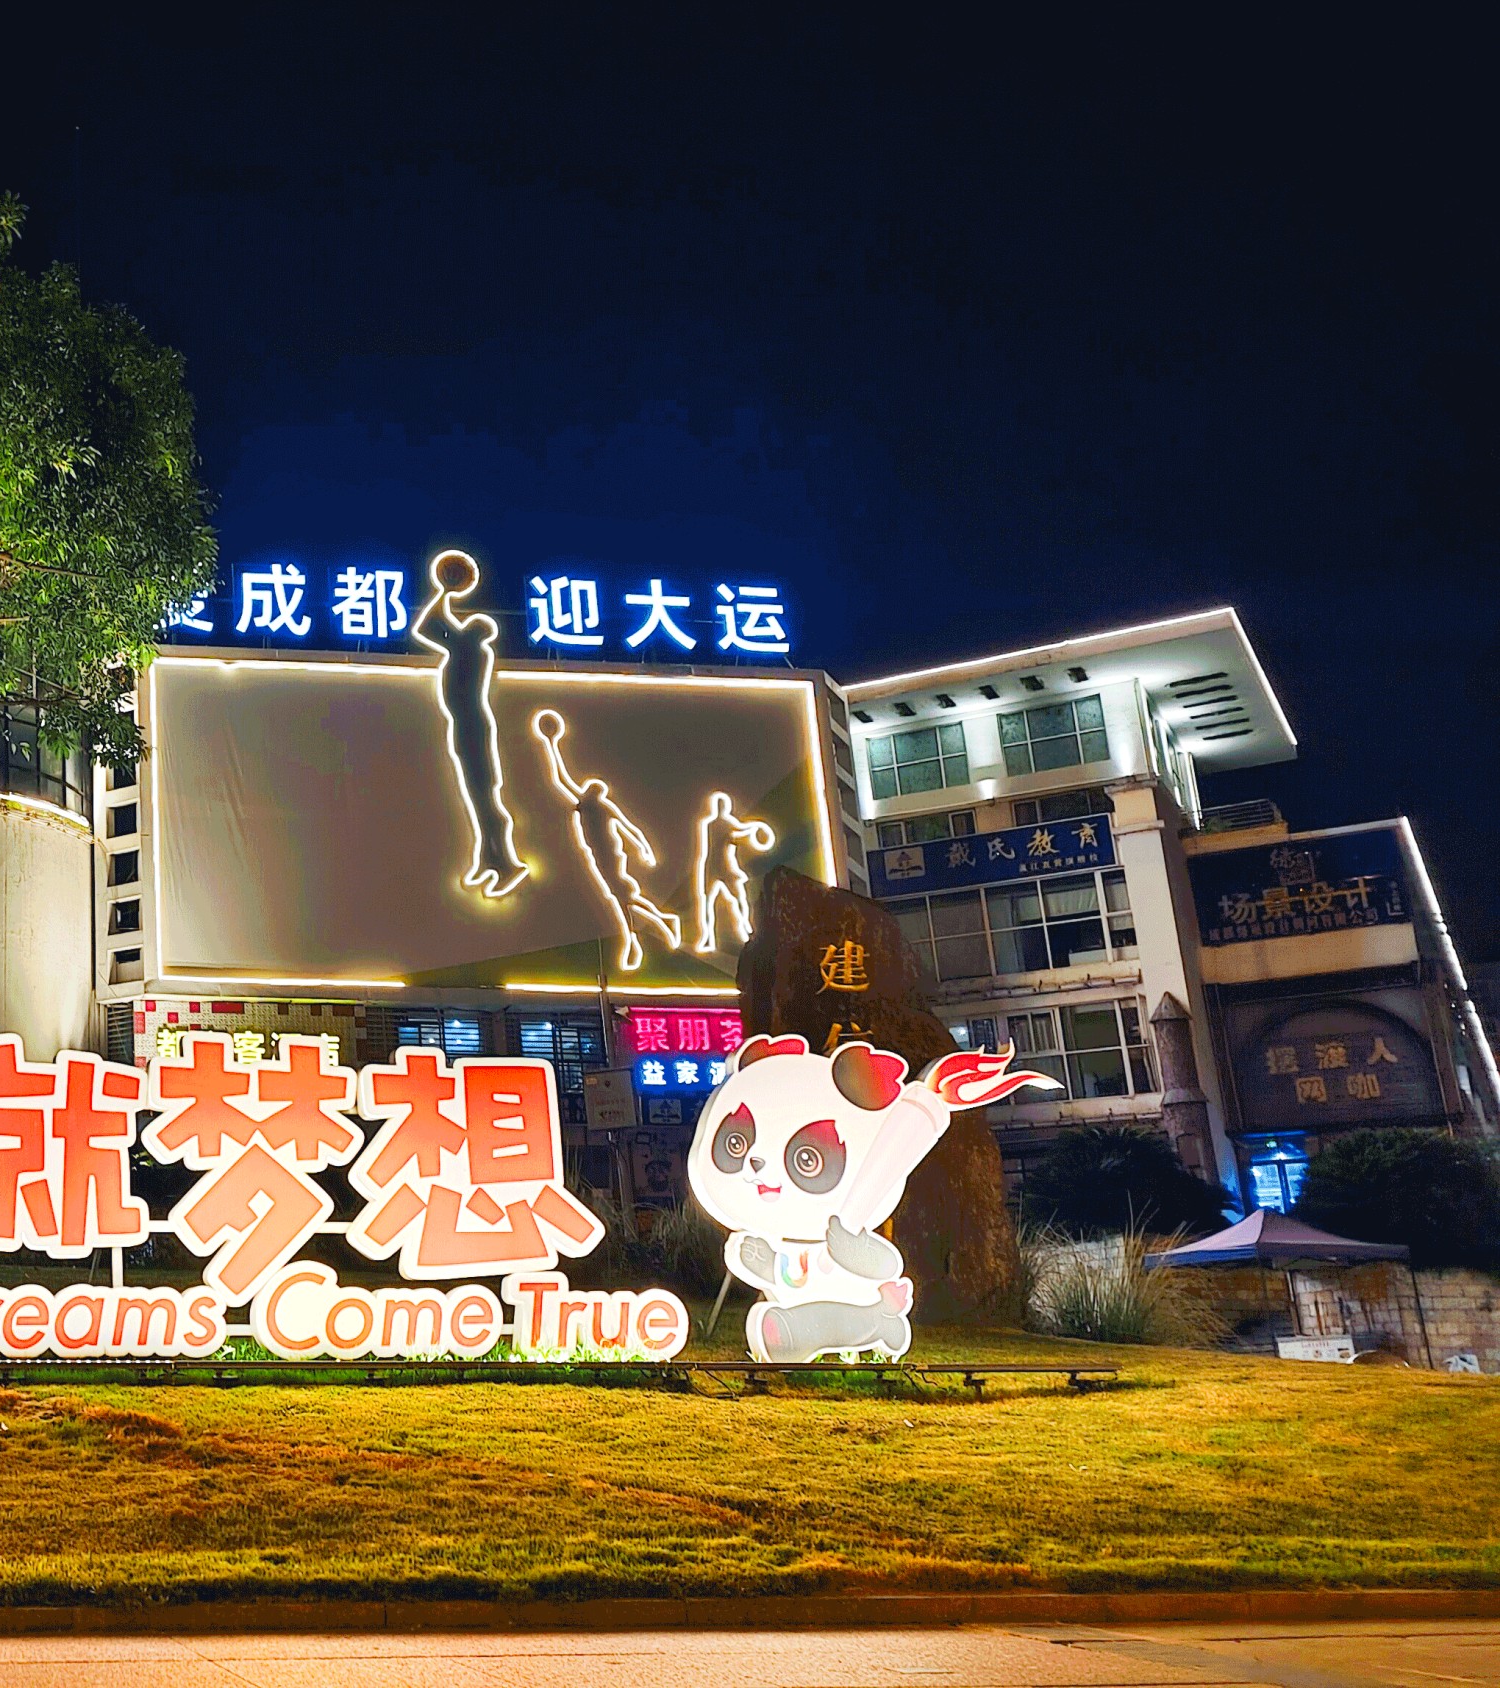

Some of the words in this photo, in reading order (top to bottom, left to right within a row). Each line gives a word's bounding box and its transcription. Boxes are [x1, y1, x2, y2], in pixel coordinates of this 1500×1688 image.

[530, 576, 790, 653] 迎大运
[267, 1272, 494, 1352] Come
[519, 1282, 679, 1350] True
